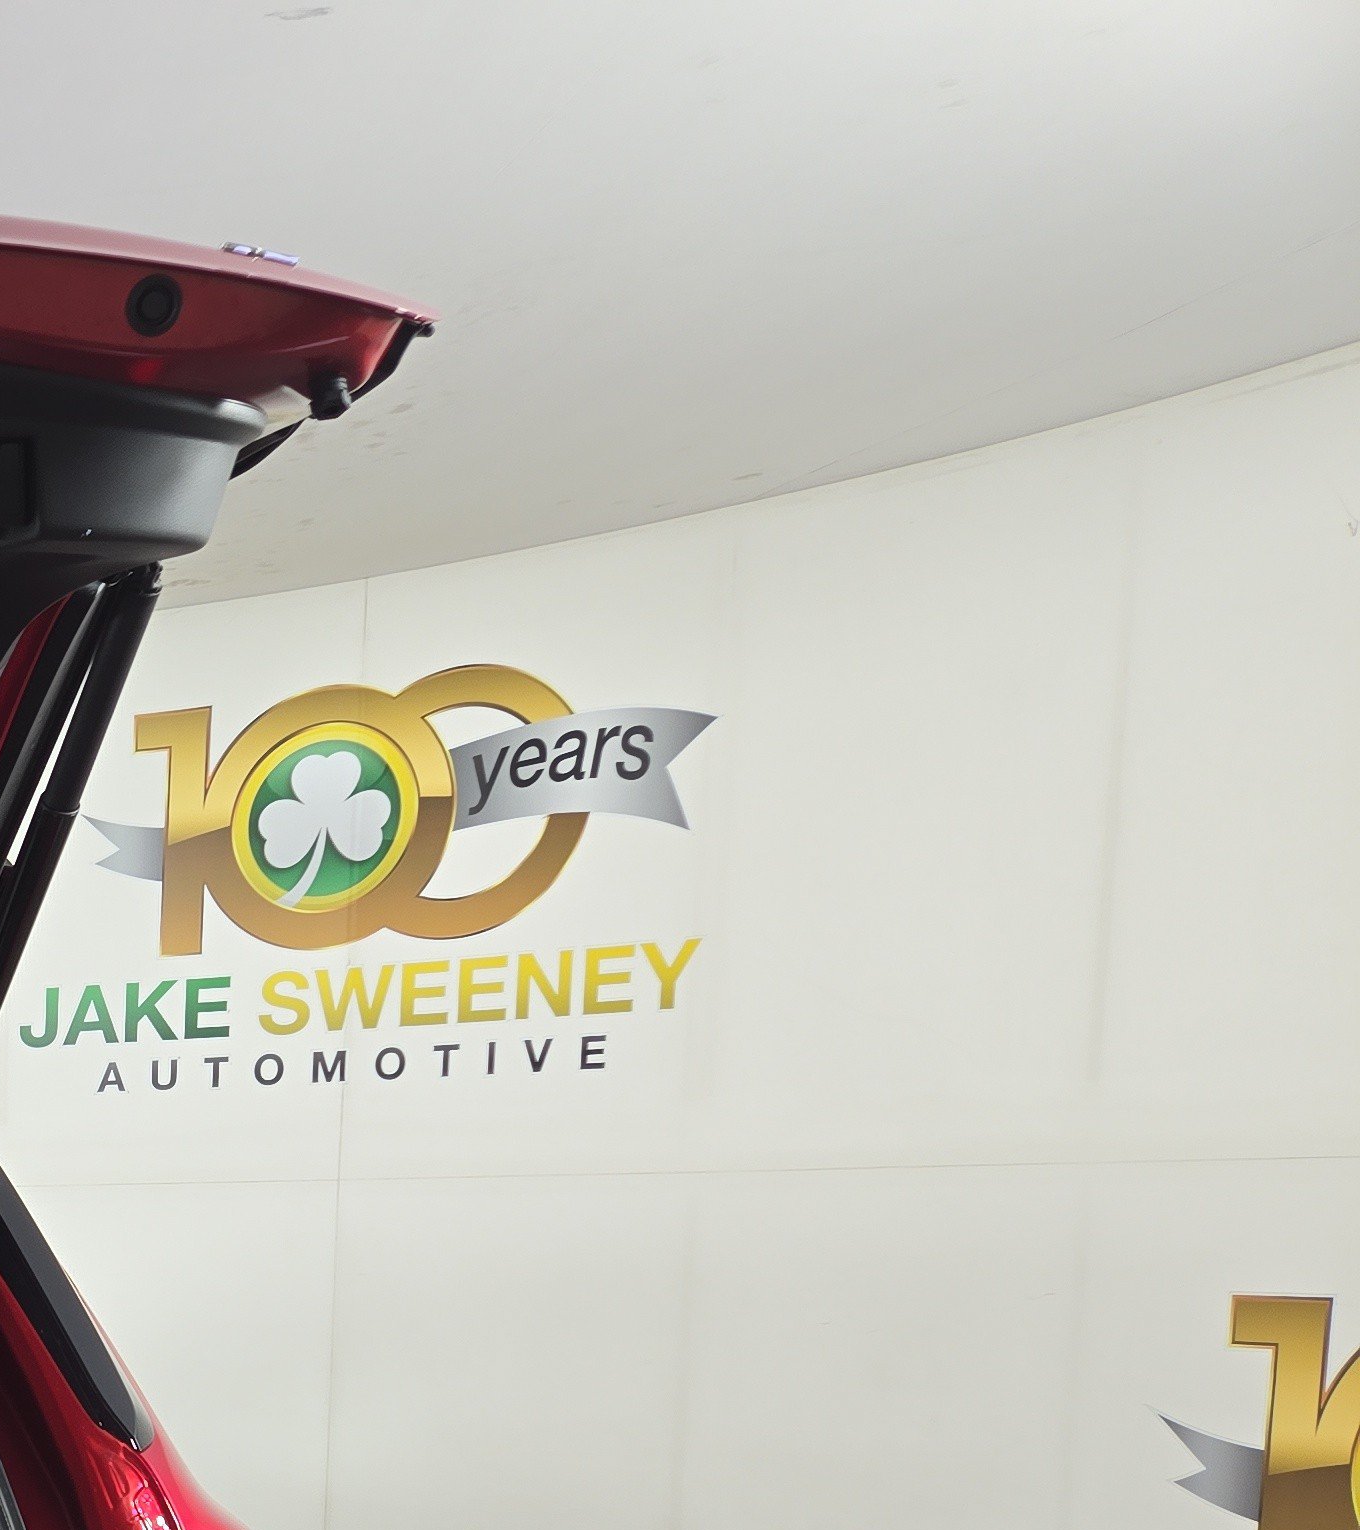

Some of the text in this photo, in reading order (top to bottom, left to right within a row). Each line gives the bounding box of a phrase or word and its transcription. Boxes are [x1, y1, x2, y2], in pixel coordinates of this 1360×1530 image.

[133, 664, 655, 957] 100 years
[19, 938, 702, 1048] JAKE SWEENEY
[97, 1034, 608, 1093] AUTOMOTIVE
